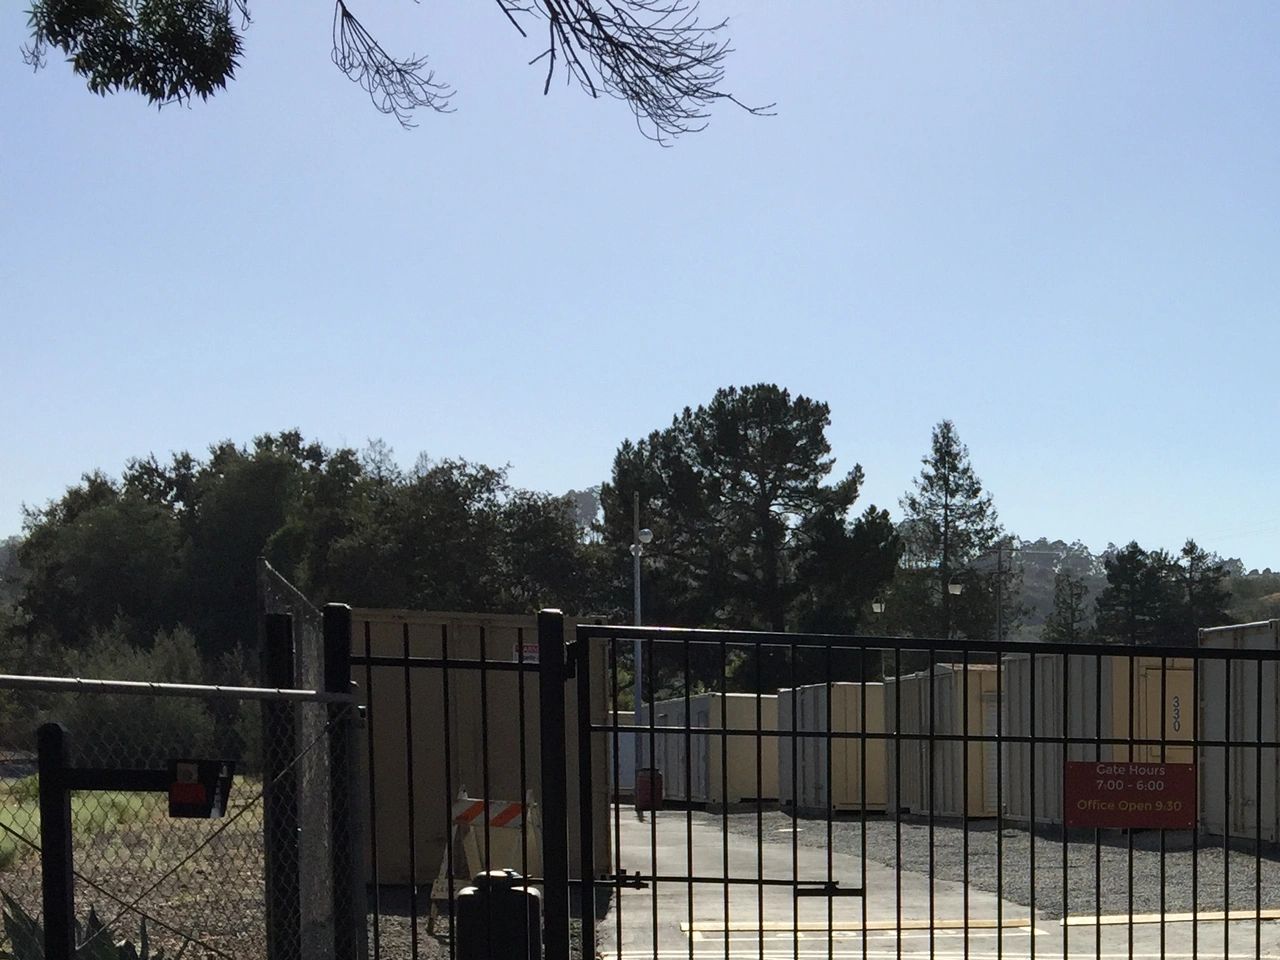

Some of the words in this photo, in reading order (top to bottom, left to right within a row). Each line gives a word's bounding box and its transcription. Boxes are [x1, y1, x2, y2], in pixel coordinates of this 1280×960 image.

[1172, 696, 1181, 732] 330
[1096, 764, 1125, 776] Gate
[1129, 765, 1166, 776] Hours
[1136, 780, 1165, 791] 6:00
[1077, 800, 1115, 811] Office
[1118, 800, 1152, 812] Open
